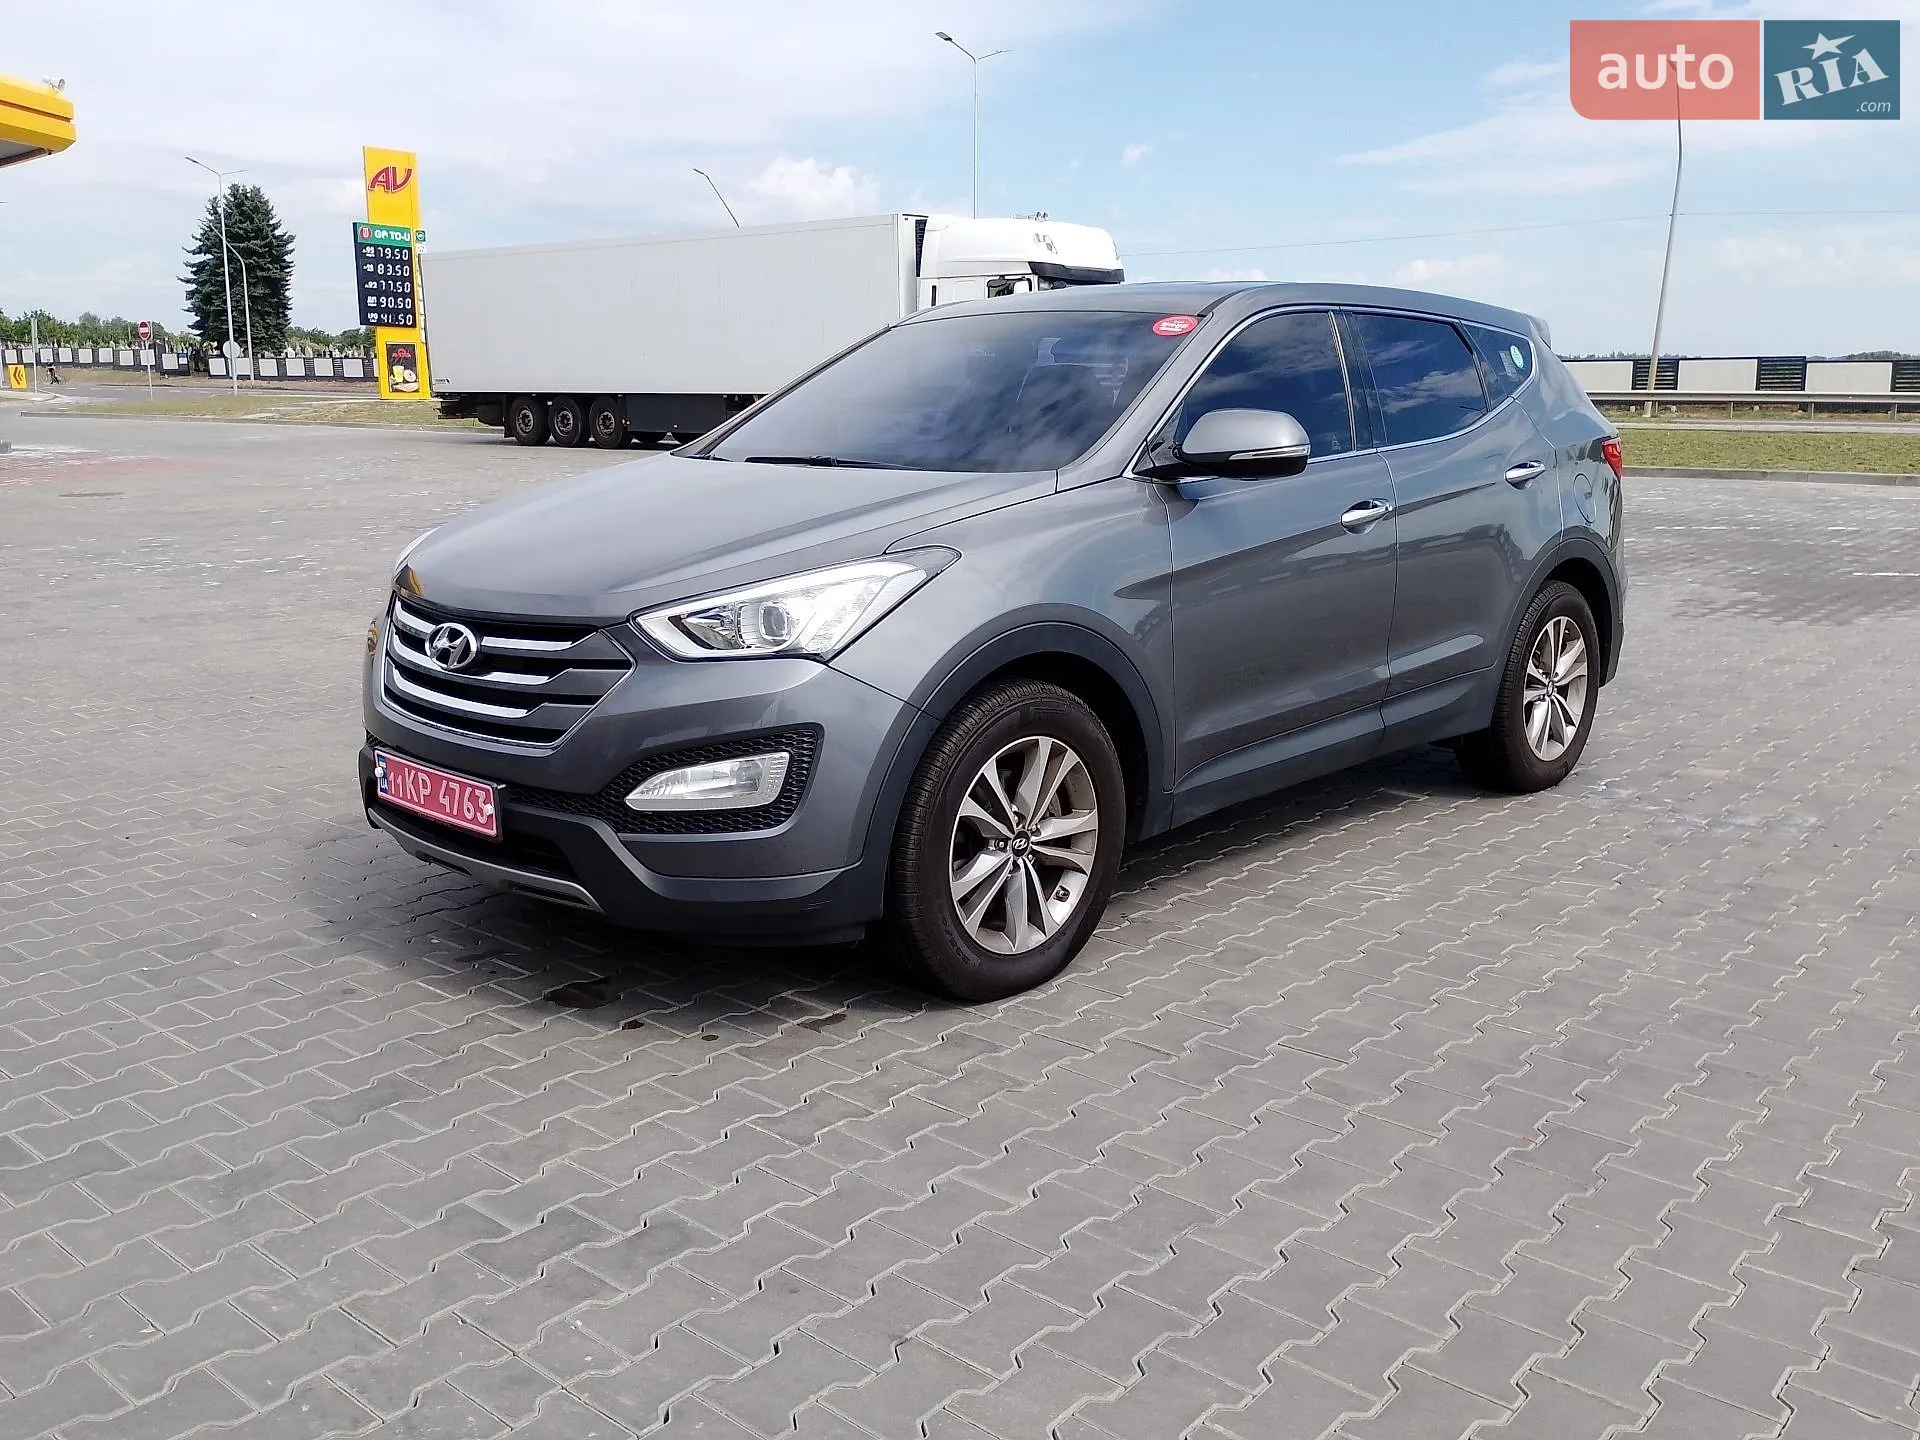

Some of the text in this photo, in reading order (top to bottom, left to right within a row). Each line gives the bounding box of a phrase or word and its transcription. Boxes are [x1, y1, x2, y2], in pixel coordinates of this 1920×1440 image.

[377, 246, 409, 261] 79.50
[377, 263, 410, 277] 83.50
[379, 280, 411, 293] 77.50
[379, 296, 412, 309] 90.50
[439, 780, 489, 825] 4763
